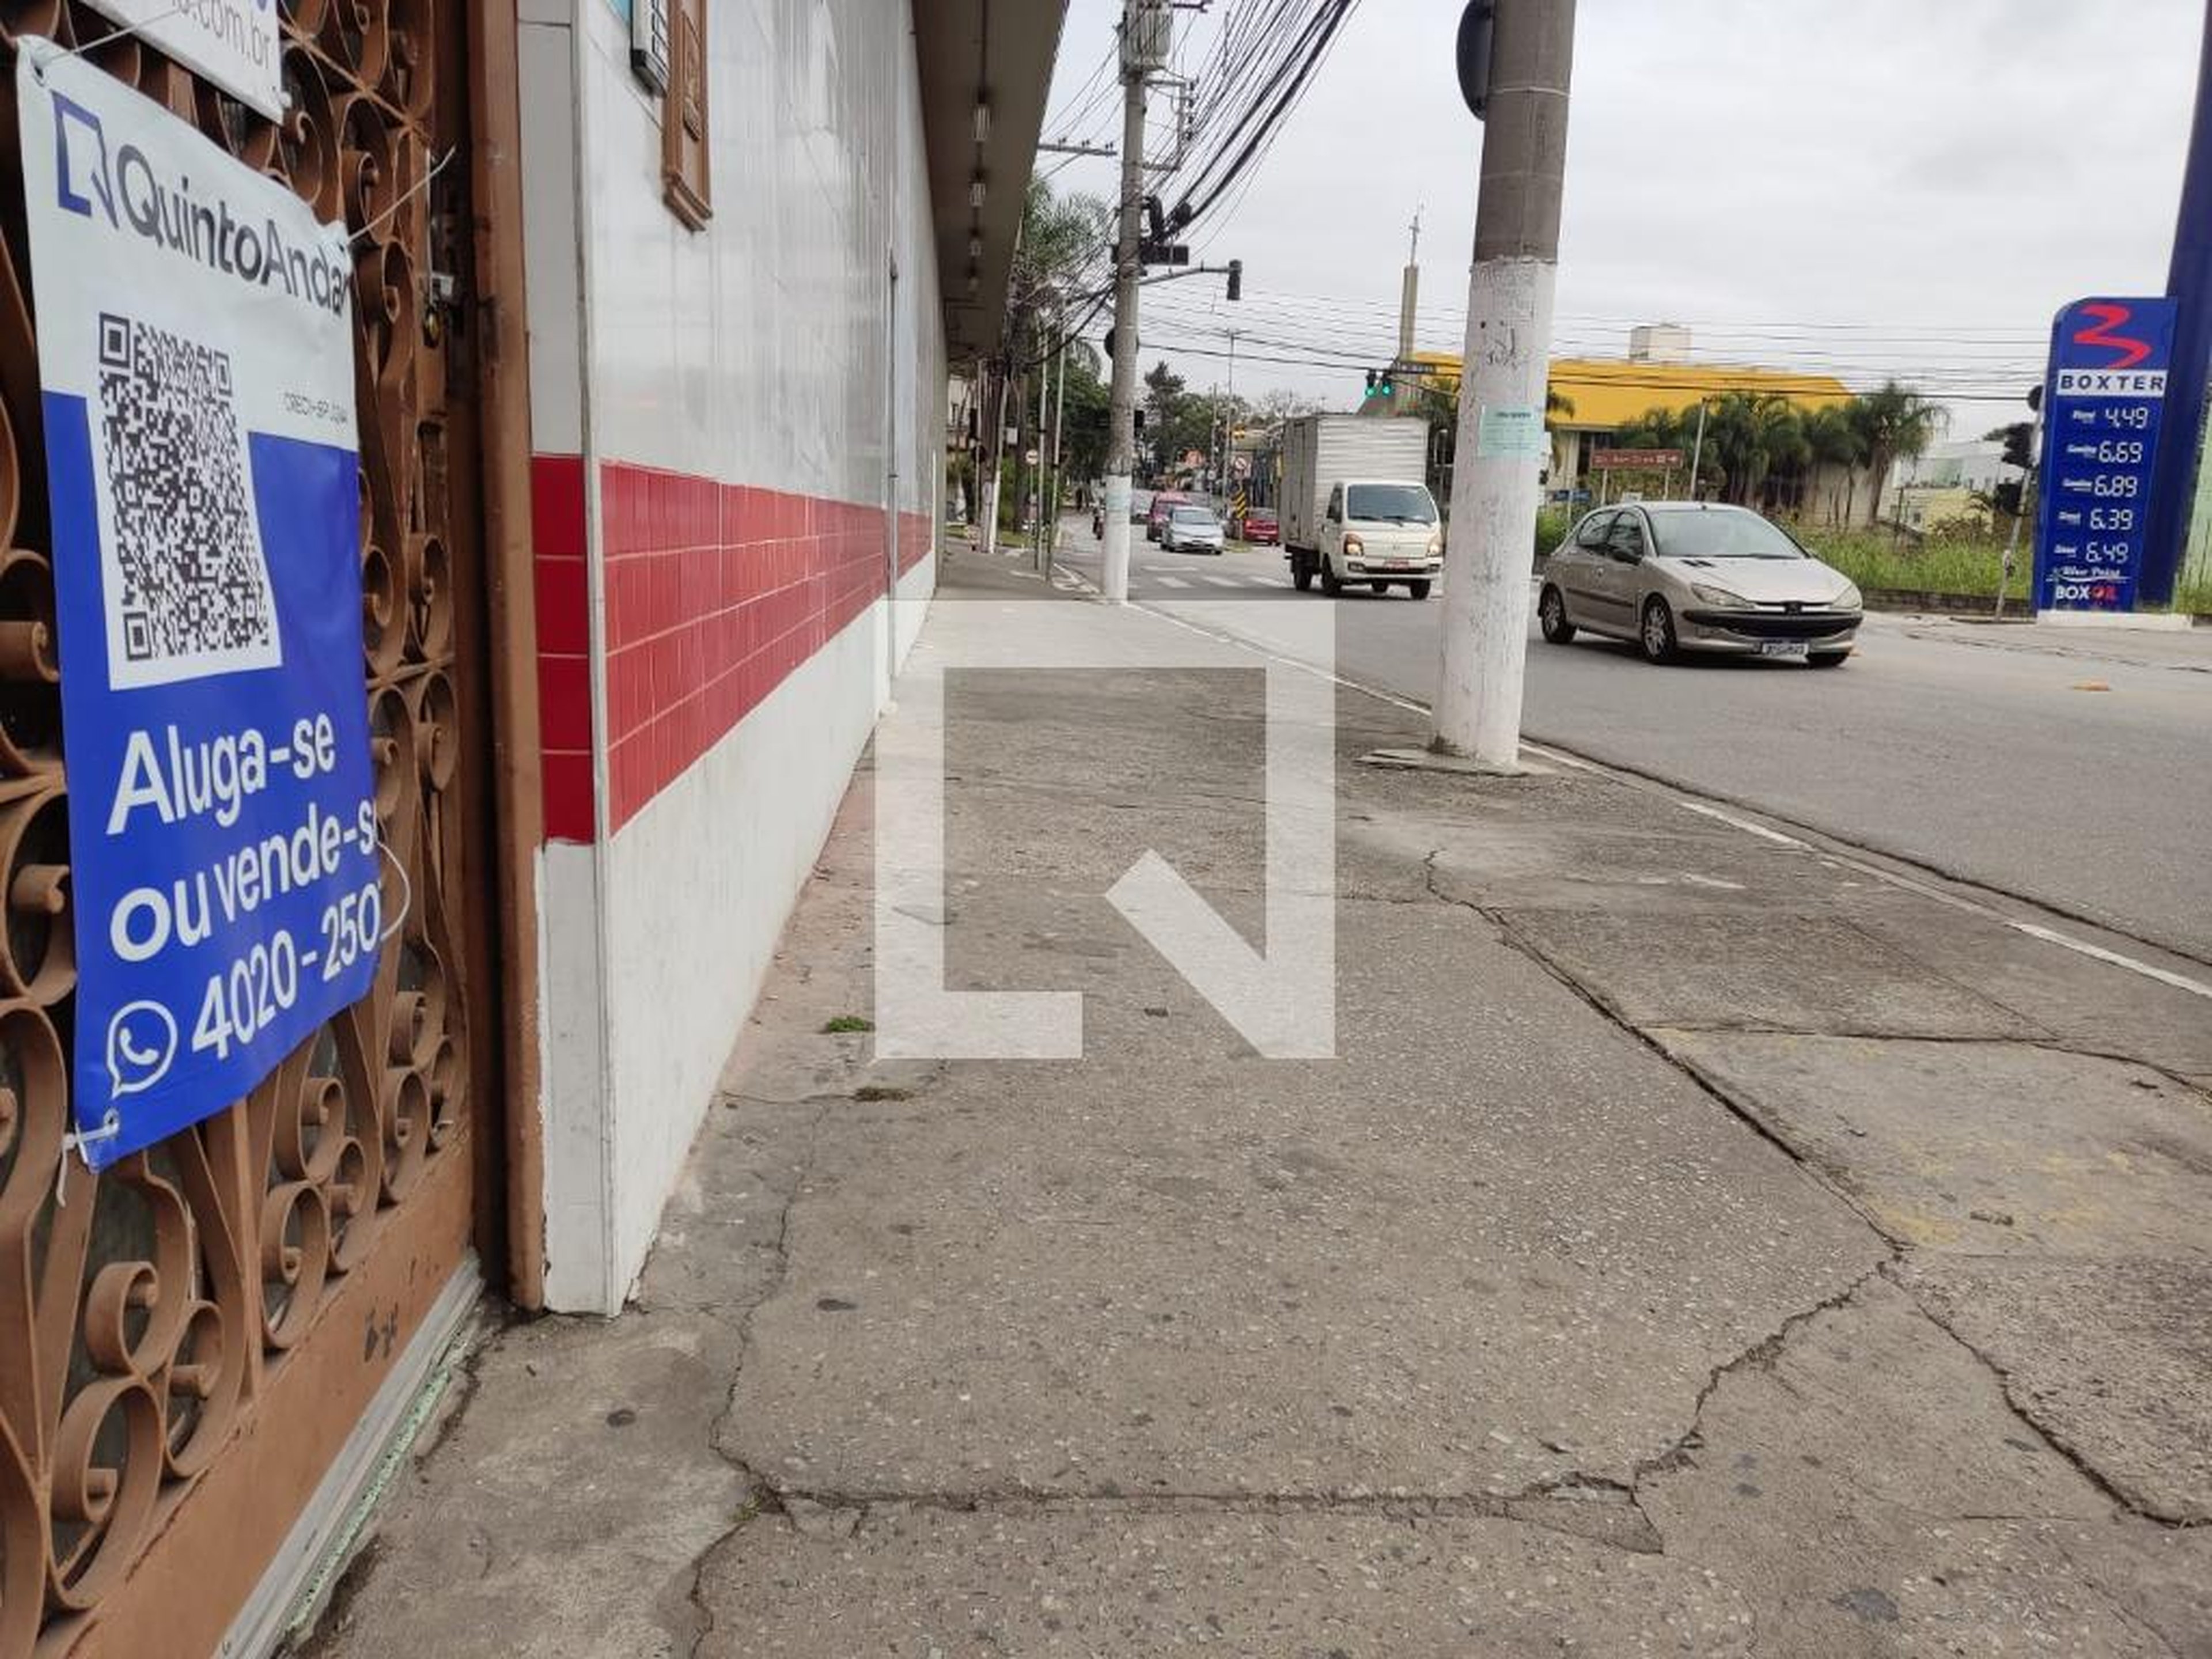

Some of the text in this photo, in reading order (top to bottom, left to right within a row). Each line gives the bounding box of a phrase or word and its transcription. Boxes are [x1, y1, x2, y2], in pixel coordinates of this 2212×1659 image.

[2060, 374, 2164, 391] BOXTER
[106, 712, 335, 835] Aluga-se
[109, 798, 374, 962] ou vende-s
[191, 879, 382, 1060] 4020-250
